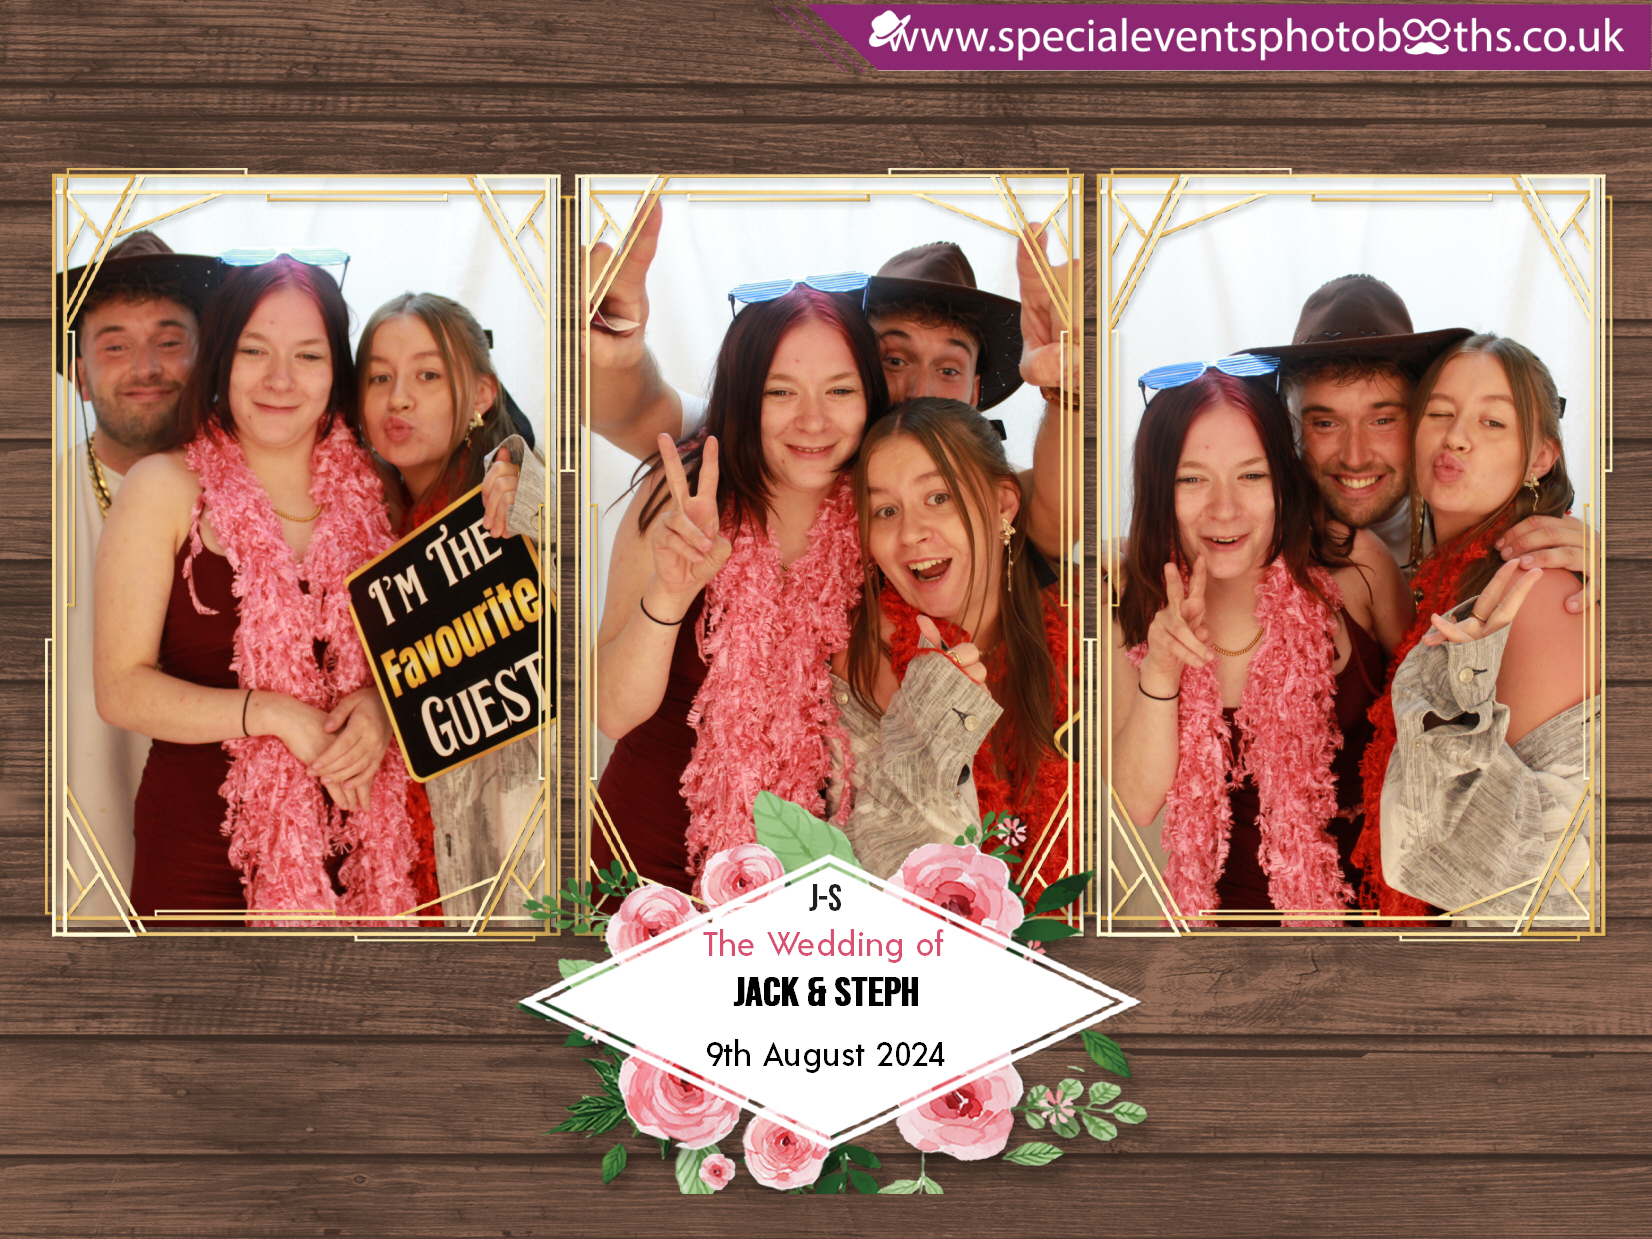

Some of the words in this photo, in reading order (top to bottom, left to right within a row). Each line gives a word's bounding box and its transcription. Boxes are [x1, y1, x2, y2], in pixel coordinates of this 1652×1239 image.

[368, 564, 429, 626] I'M
[425, 517, 503, 587] THE
[380, 577, 544, 698] Favourite
[421, 651, 553, 757] GUEST
